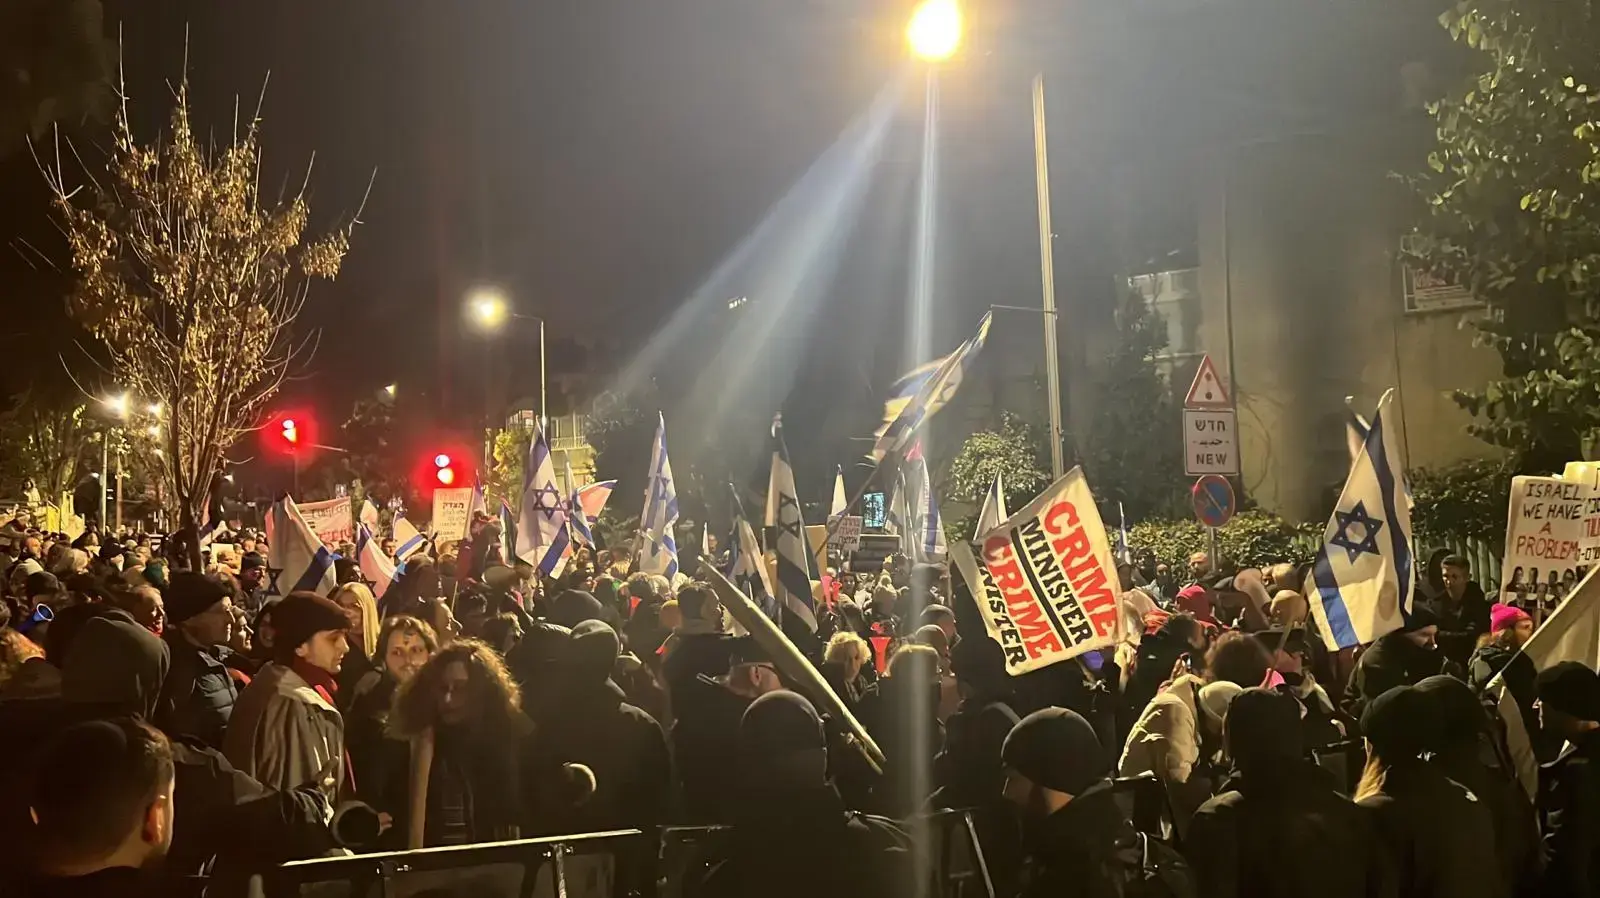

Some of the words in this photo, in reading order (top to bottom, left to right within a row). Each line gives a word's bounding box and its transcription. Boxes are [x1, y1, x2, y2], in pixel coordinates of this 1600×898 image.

[1195, 419, 1226, 432] חדש
[1196, 453, 1227, 465] NEW
[1523, 503, 1543, 520] WE
[1547, 503, 1583, 520] HAVE
[1539, 521, 1552, 535] A
[1516, 535, 1579, 560] PROBLEM
[1044, 501, 1118, 638] CRIME
[1019, 516, 1094, 646] MINISTER
[983, 536, 1064, 660] CRIME
